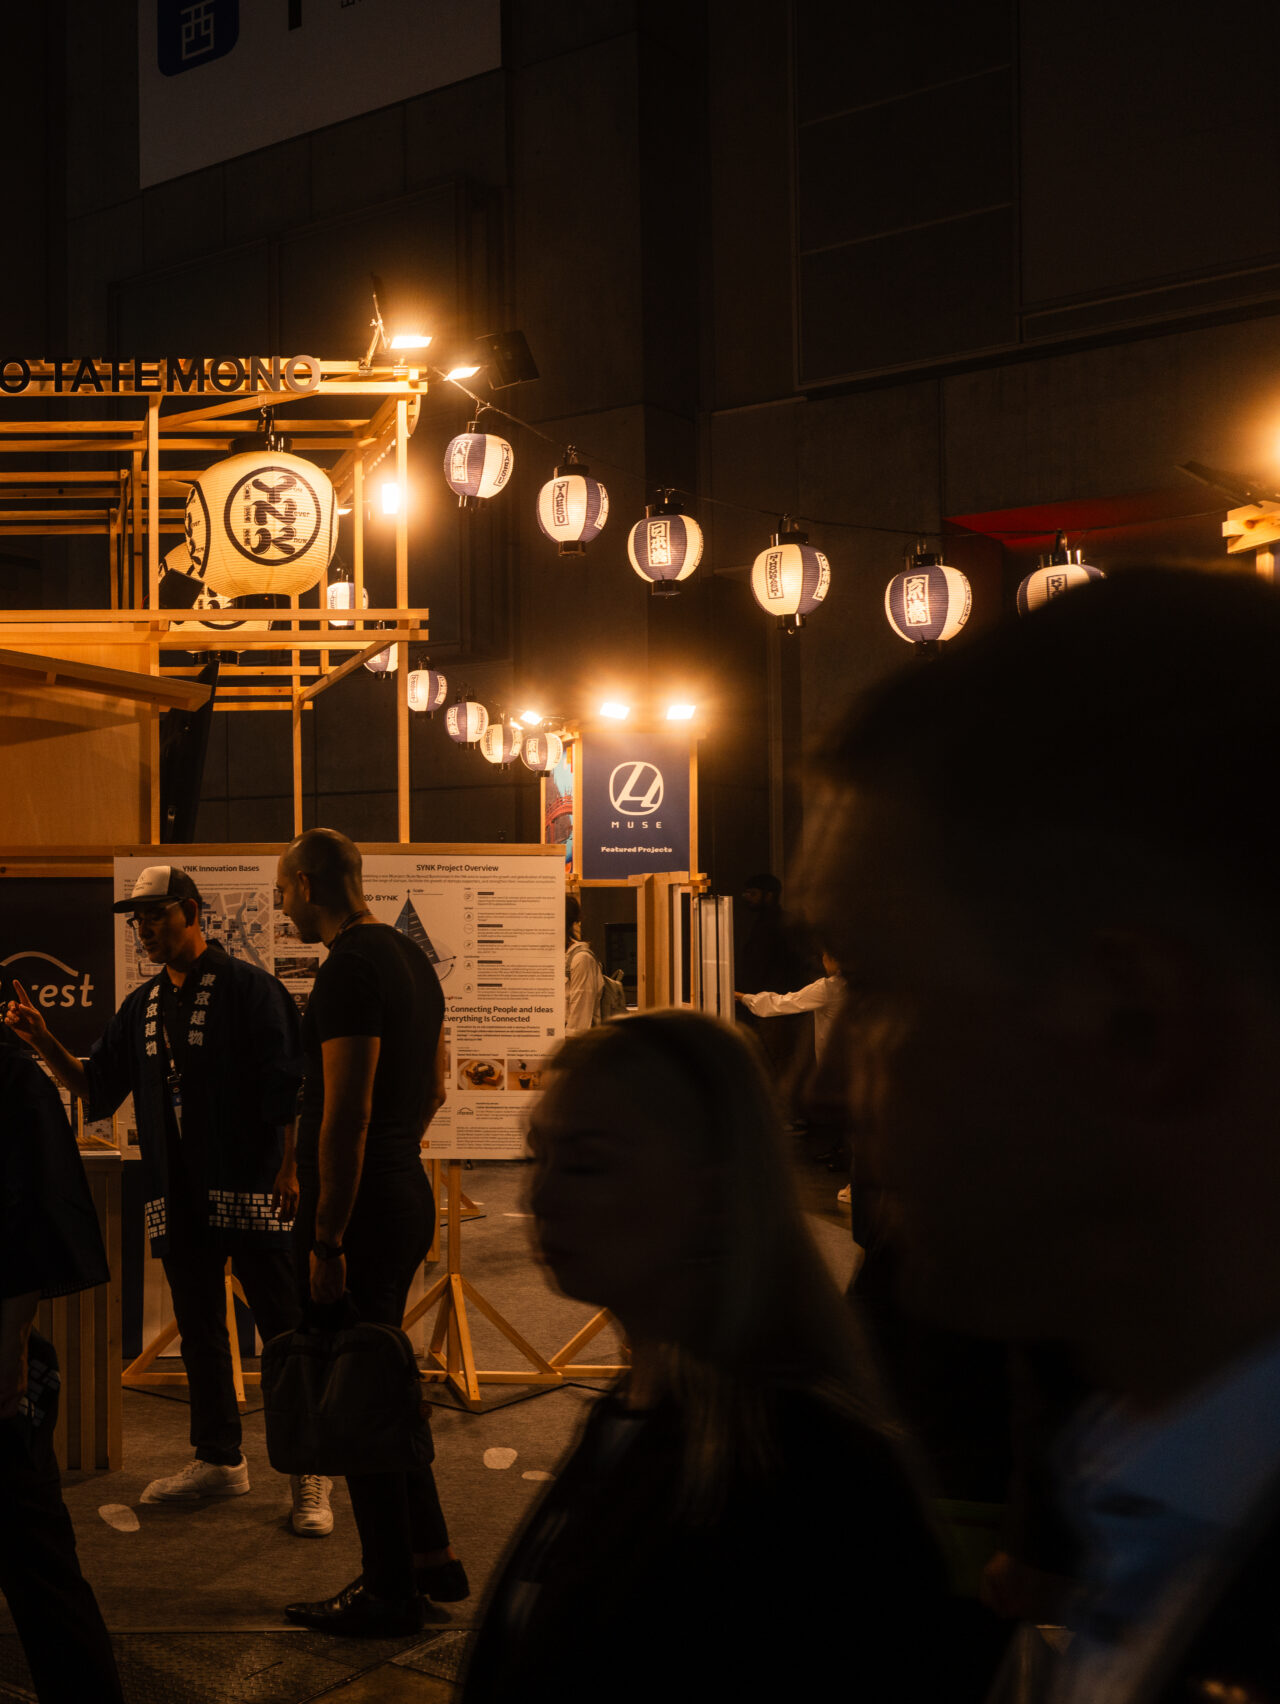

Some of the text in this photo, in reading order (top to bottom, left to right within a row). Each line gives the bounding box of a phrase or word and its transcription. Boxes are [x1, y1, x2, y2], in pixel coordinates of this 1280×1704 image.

[180, 0, 216, 61] 西
[43, 355, 321, 394] TATEMONO
[498, 447, 511, 486] YAESU
[555, 482, 568, 525] YAESU
[650, 522, 668, 565] 日本橋
[906, 577, 929, 624] 京橋
[611, 821, 663, 829] MUSE
[437, 864, 463, 873] Project
[464, 864, 499, 872] Overview
[637, 846, 673, 854] Projects
[450, 1005, 492, 1014] Connecting
[493, 1006, 518, 1014] People
[491, 1015, 530, 1023] Connected
